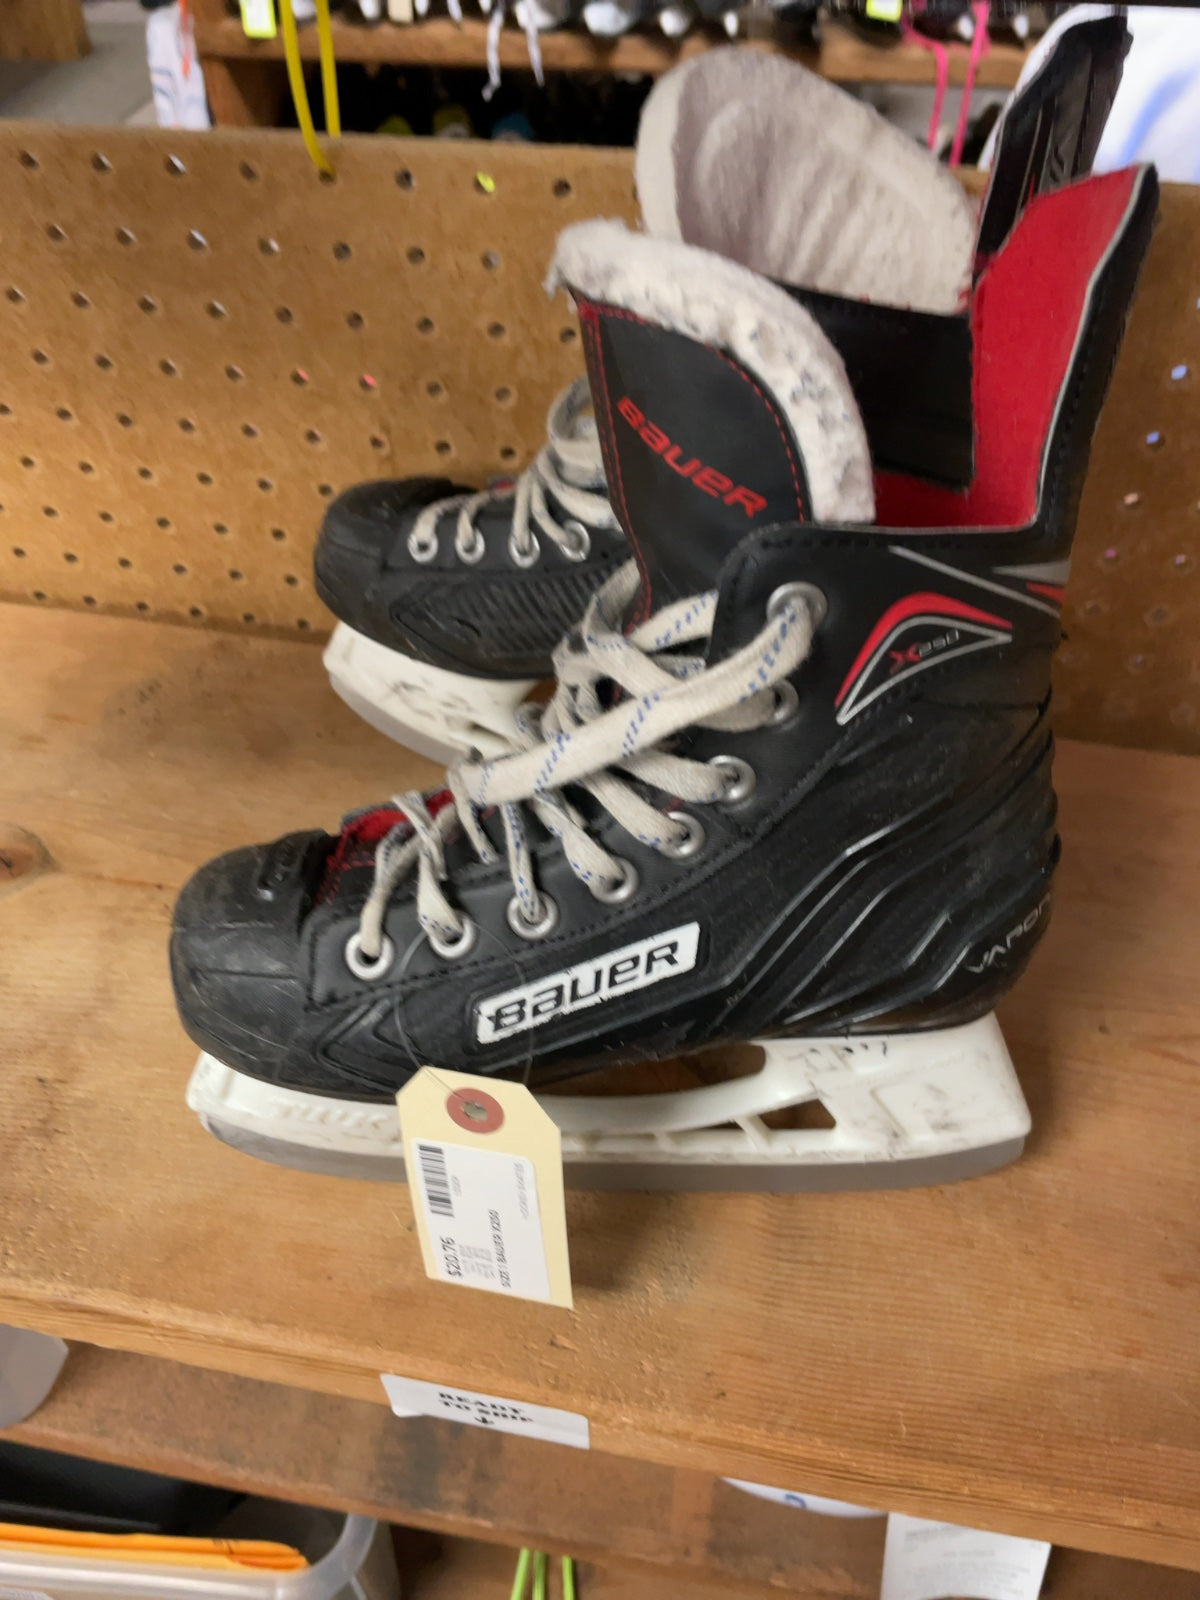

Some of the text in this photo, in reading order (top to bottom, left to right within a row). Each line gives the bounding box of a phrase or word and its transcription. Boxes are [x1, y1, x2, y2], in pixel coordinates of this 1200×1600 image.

[440, 1234, 463, 1278] $20.76
[493, 1233, 507, 1264] BAUER
[439, 1391, 524, 1414] READY
[439, 1399, 471, 1411] TO
